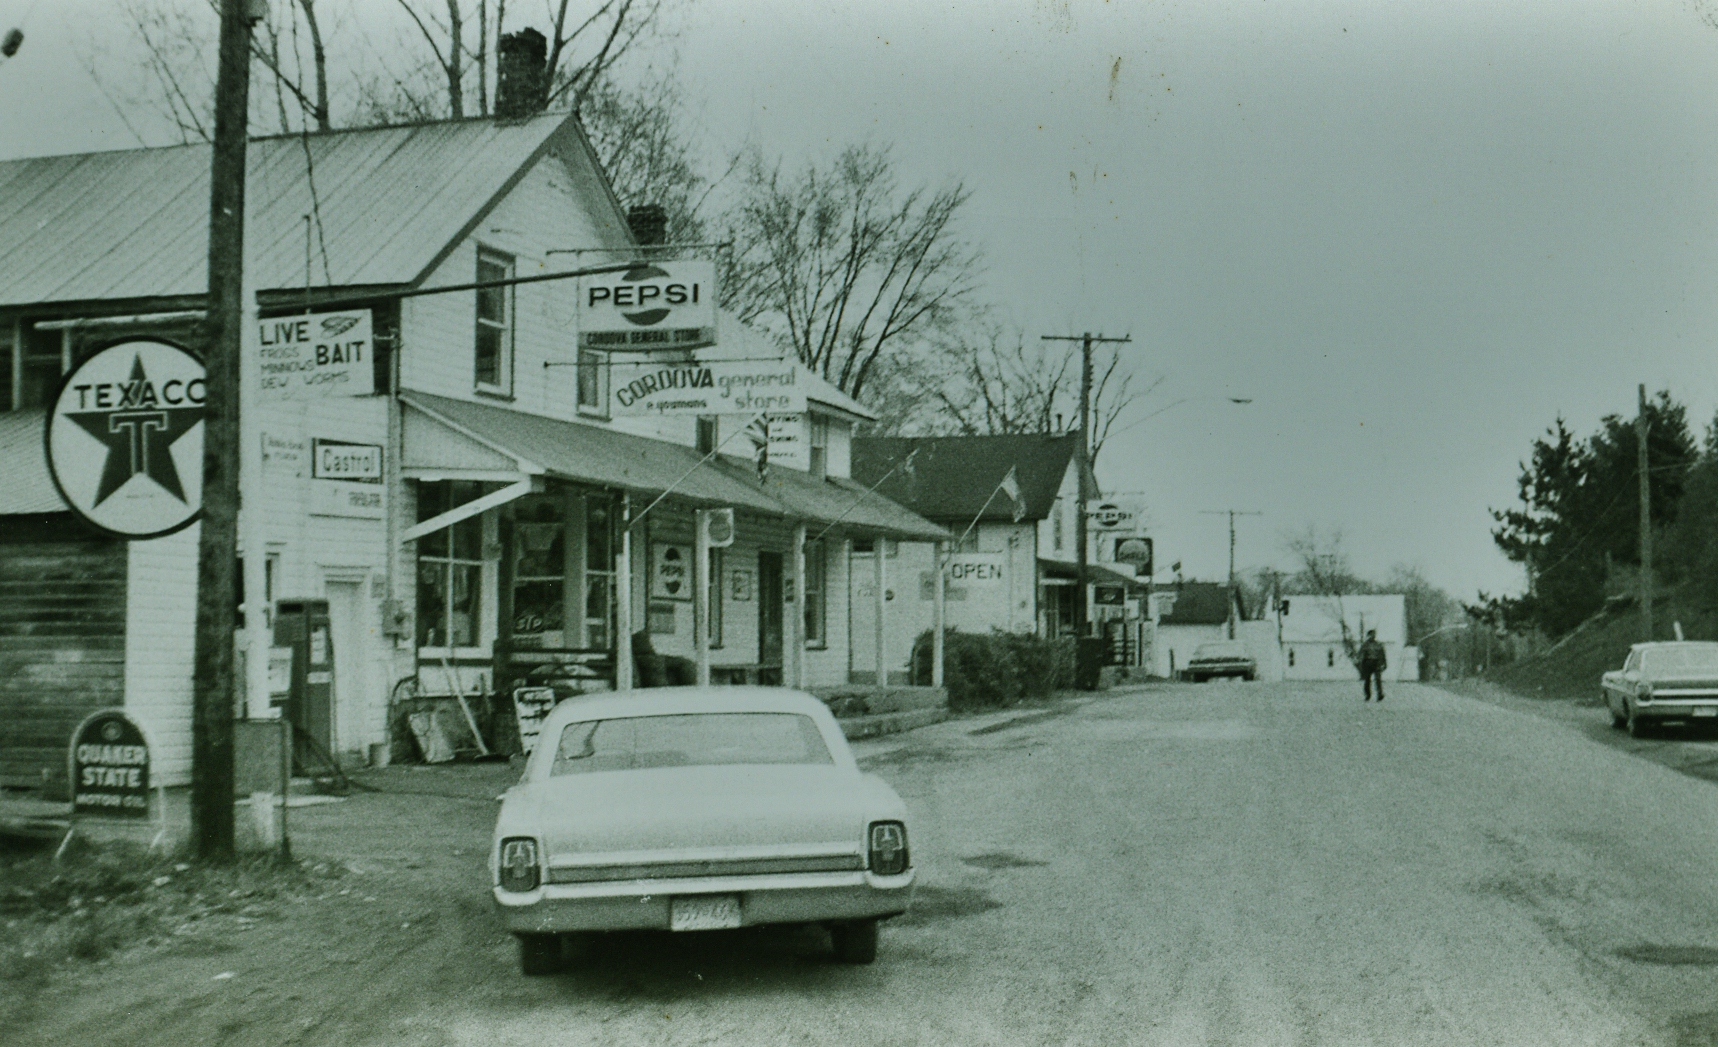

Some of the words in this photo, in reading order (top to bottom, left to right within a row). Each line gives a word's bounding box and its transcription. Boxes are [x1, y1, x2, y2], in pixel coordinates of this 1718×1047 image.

[588, 283, 699, 307] PEPSI
[259, 320, 311, 346] LIVE
[315, 340, 365, 366] BAIT
[74, 379, 207, 410] TEXACO
[615, 368, 715, 409] CORDOVA
[717, 366, 796, 399] general
[735, 390, 790, 411] store
[322, 447, 376, 473] Castrol
[951, 563, 1002, 580] OPEN
[77, 743, 146, 766] QUAKER
[82, 765, 142, 788] STATE
